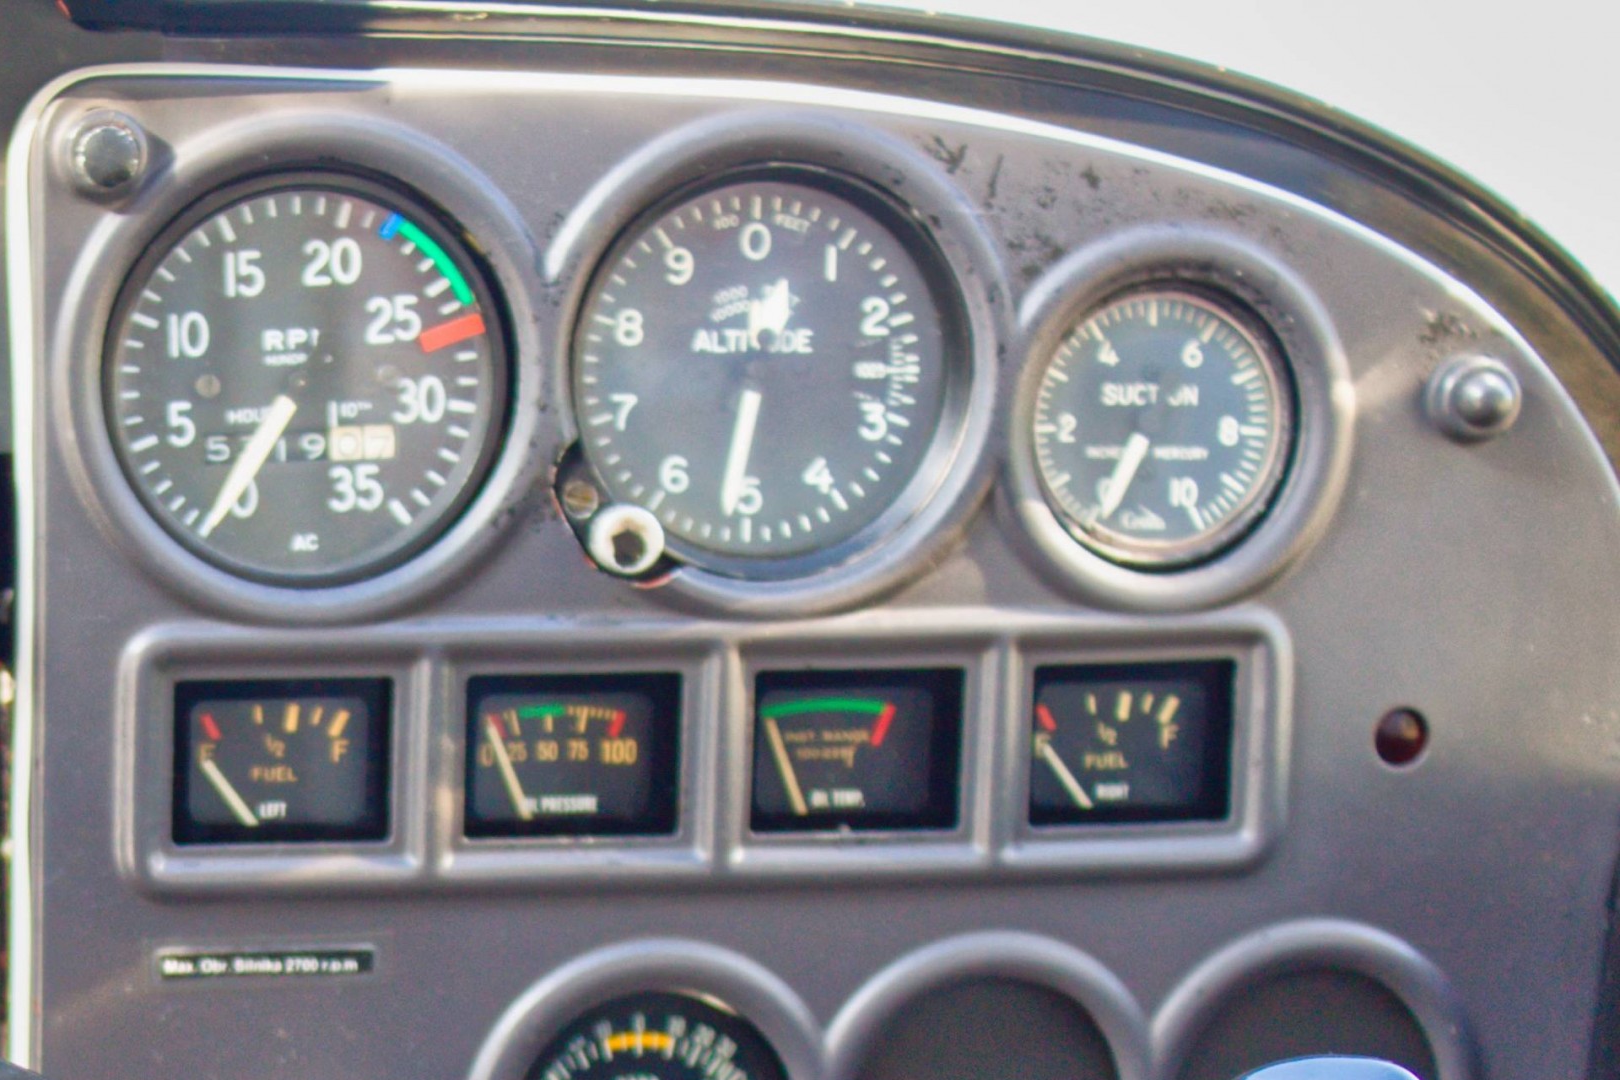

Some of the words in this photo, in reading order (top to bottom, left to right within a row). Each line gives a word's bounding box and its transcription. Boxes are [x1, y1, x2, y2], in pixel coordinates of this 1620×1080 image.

[739, 222, 772, 260] 0
[224, 251, 265, 297] 15
[302, 238, 361, 286] 20
[664, 248, 695, 285] 9
[825, 245, 837, 282] 1
[167, 312, 209, 357] 10
[366, 295, 421, 344] 25
[614, 310, 644, 346] 8
[860, 297, 890, 337] 2
[692, 328, 814, 353] ALTIDE
[1097, 341, 1120, 367] 4
[1182, 340, 1203, 368] 6
[393, 376, 446, 423] 30
[612, 394, 638, 431] 7
[167, 401, 195, 447] 5
[858, 401, 888, 441] 3
[1057, 413, 1077, 443] 2
[1217, 415, 1239, 447] 8
[329, 465, 383, 512] 35
[658, 455, 689, 494] 6
[804, 457, 834, 494] 4
[1169, 477, 1198, 508] 10
[737, 477, 763, 515] 5
[291, 534, 319, 552] AC
[332, 739, 350, 763] F
[536, 740, 559, 761] 50
[601, 738, 638, 764] 100
[1160, 724, 1178, 748] F
[250, 765, 297, 782] FUEL
[1085, 753, 1128, 770] FUEL
